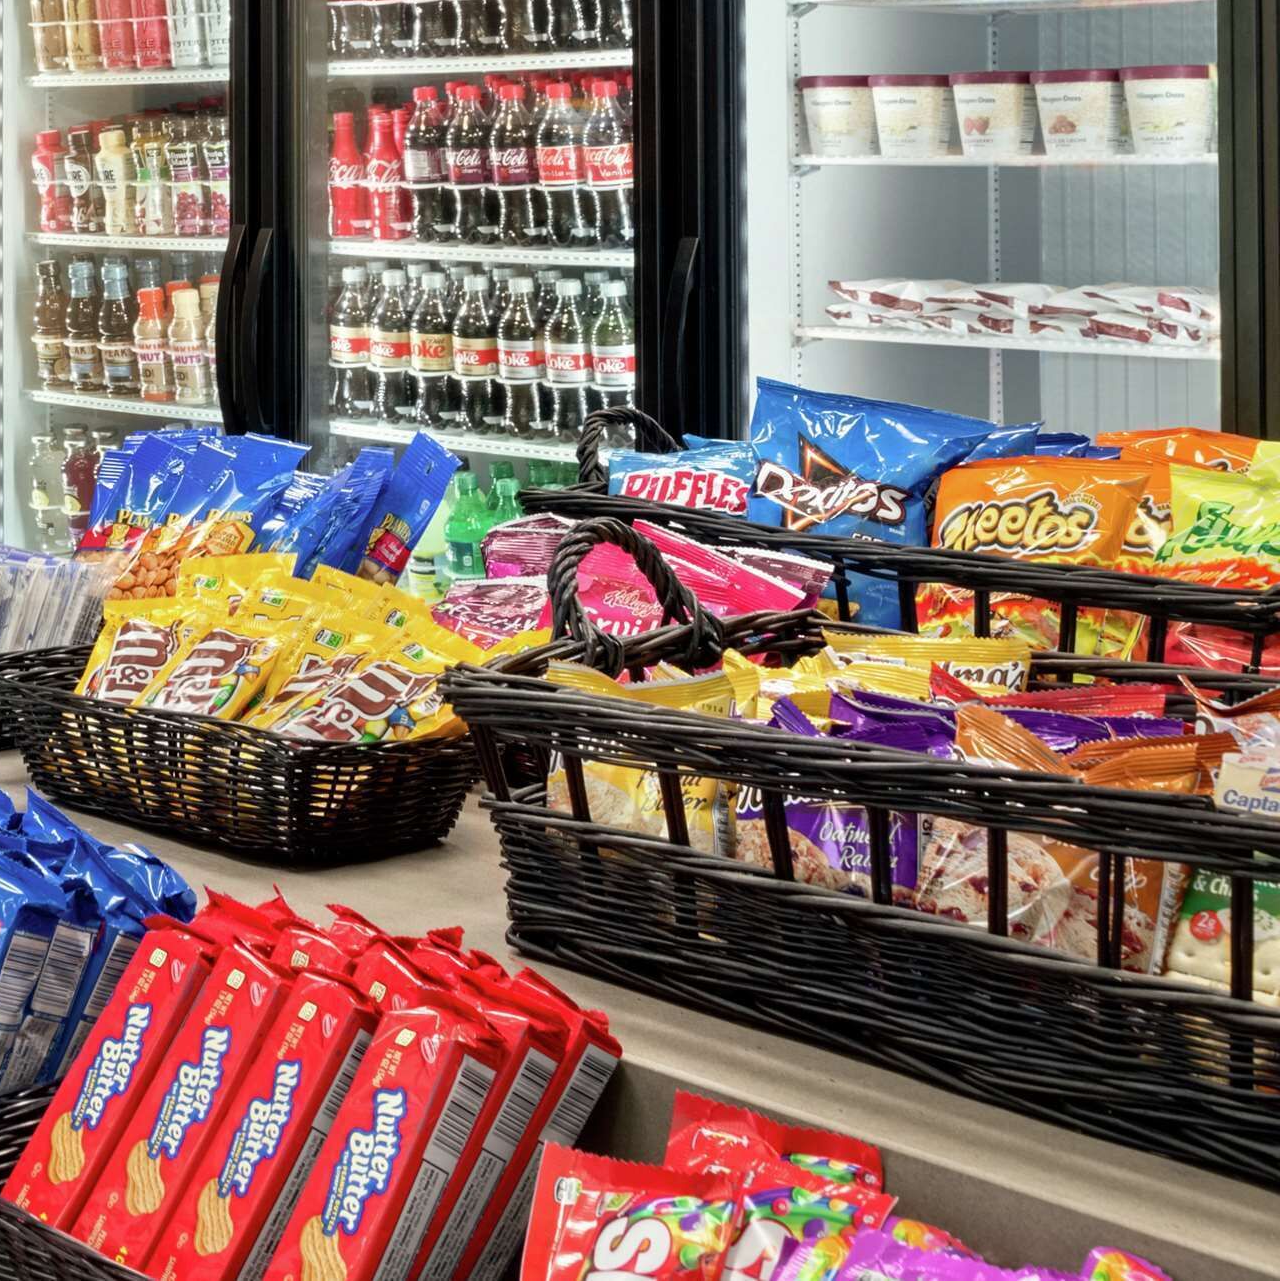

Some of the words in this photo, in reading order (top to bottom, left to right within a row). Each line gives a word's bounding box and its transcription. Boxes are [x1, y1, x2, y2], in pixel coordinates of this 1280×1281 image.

[624, 468, 749, 515] RUFFLES
[755, 460, 907, 523] Doritos
[940, 490, 1098, 553] Cheetos
[700, 703, 724, 715] 1914
[1194, 875, 1207, 892] &
[85, 1041, 122, 1127] Butter
[114, 1006, 150, 1092] Nutter
[193, 1029, 229, 1120] Nutter
[165, 1064, 200, 1155] Butter
[234, 1100, 272, 1194] Butter
[261, 1062, 299, 1155] Nutter
[369, 1091, 404, 1191] Nutter
[340, 1132, 375, 1231] Butter
